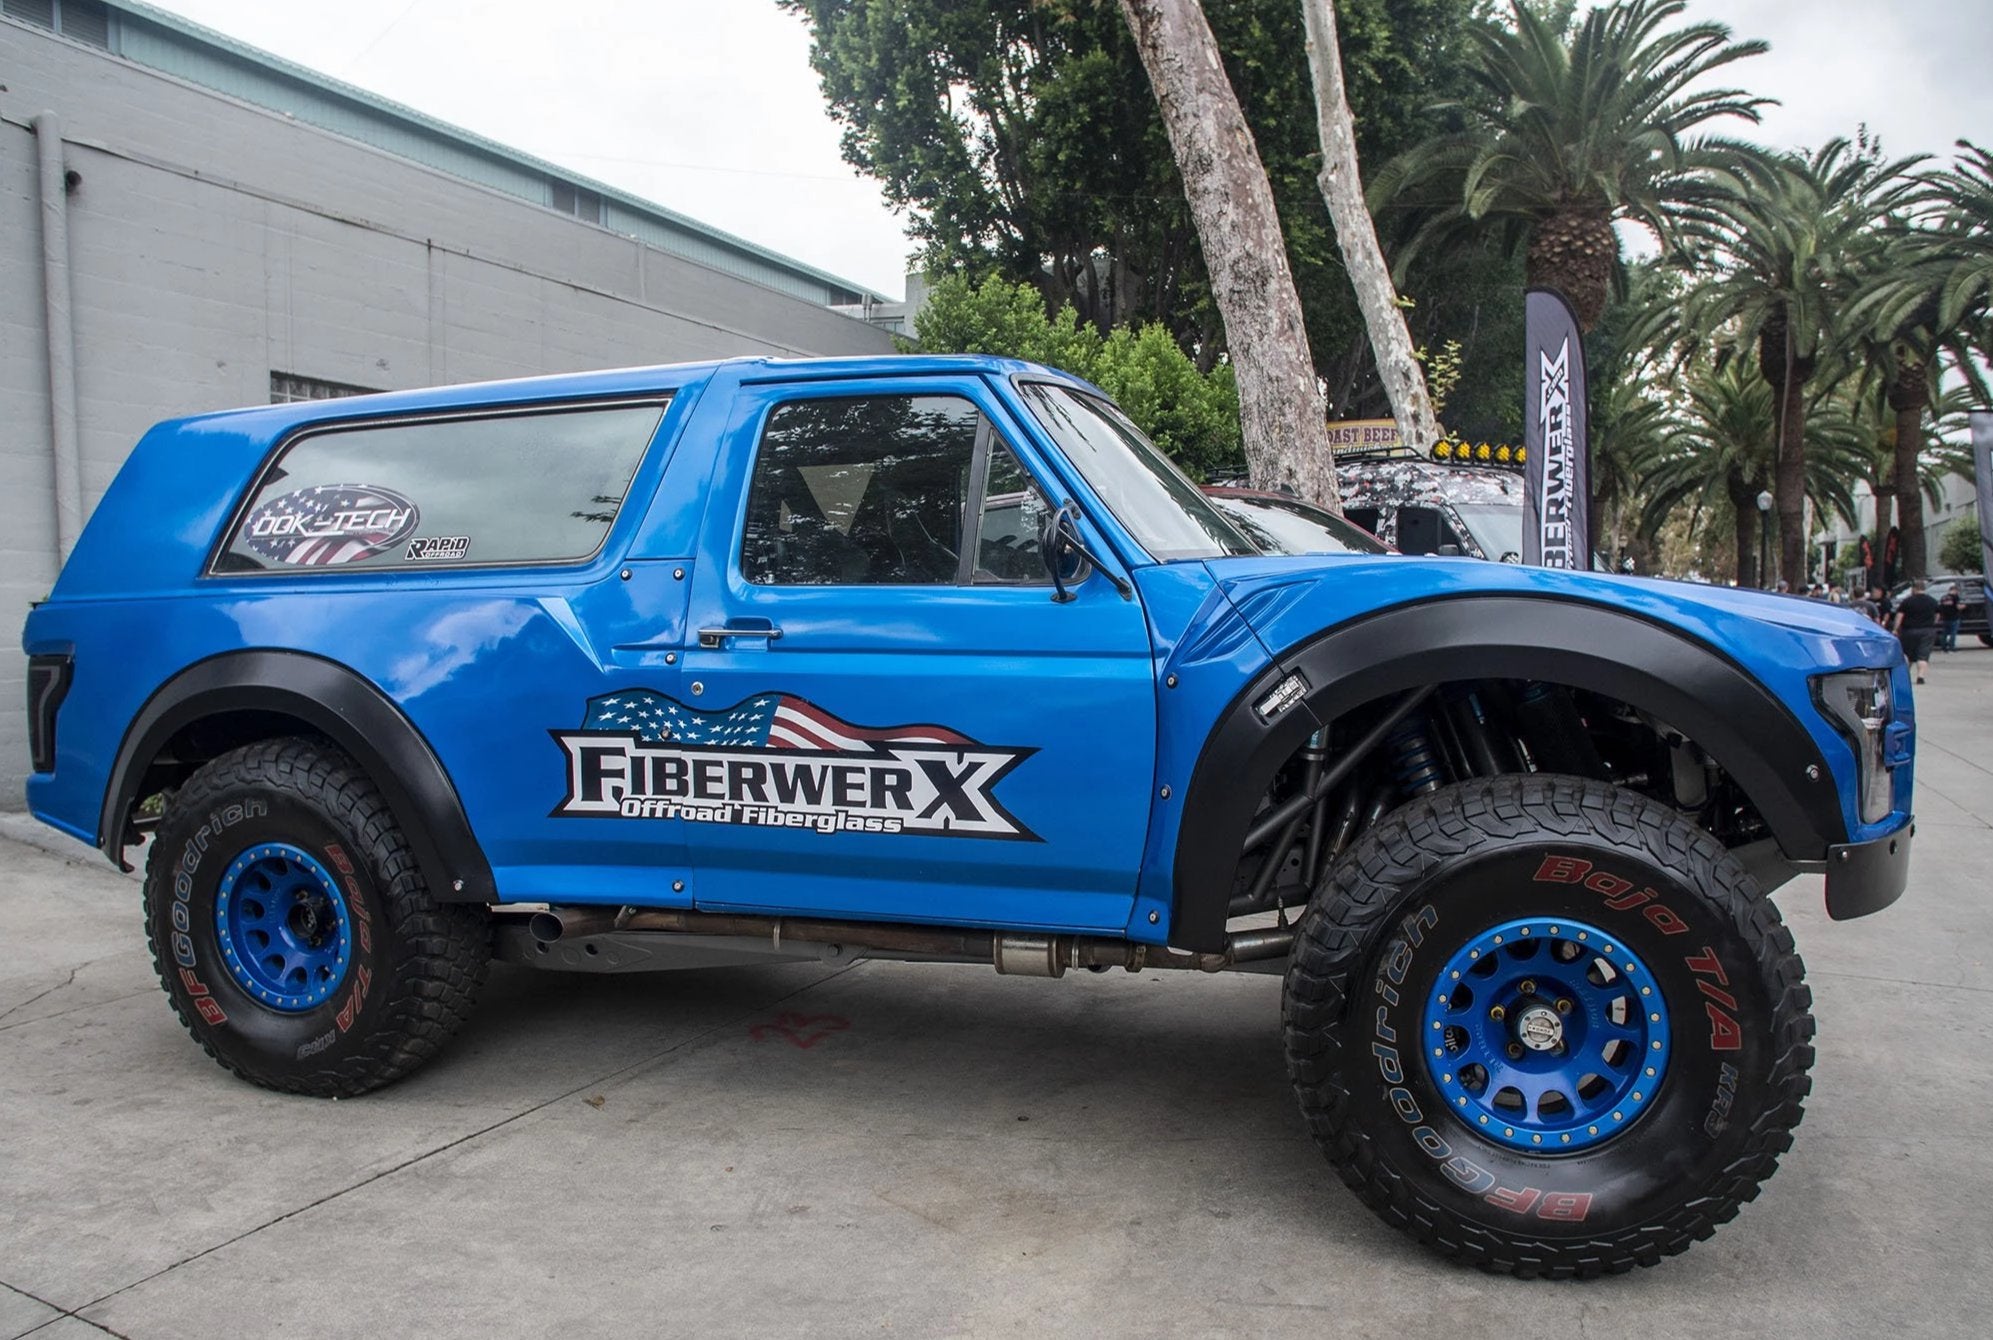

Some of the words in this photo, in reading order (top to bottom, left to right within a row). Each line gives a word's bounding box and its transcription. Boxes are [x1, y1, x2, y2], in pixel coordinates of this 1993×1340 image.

[1326, 427, 1360, 444] OAST
[1363, 426, 1399, 443] BEEF
[1543, 355, 1566, 569] BERWERX
[578, 745, 993, 824] FIBERWERX
[620, 798, 735, 823] Offroad
[742, 805, 902, 835] Fiberglass
[171, 797, 269, 1027] BFGoodrich
[323, 843, 372, 954] Baja
[1531, 854, 1691, 937] Baja
[1684, 945, 1743, 1052] T/A
[336, 966, 374, 1033] T/A
[1371, 902, 1595, 1223] BFGoodrich
